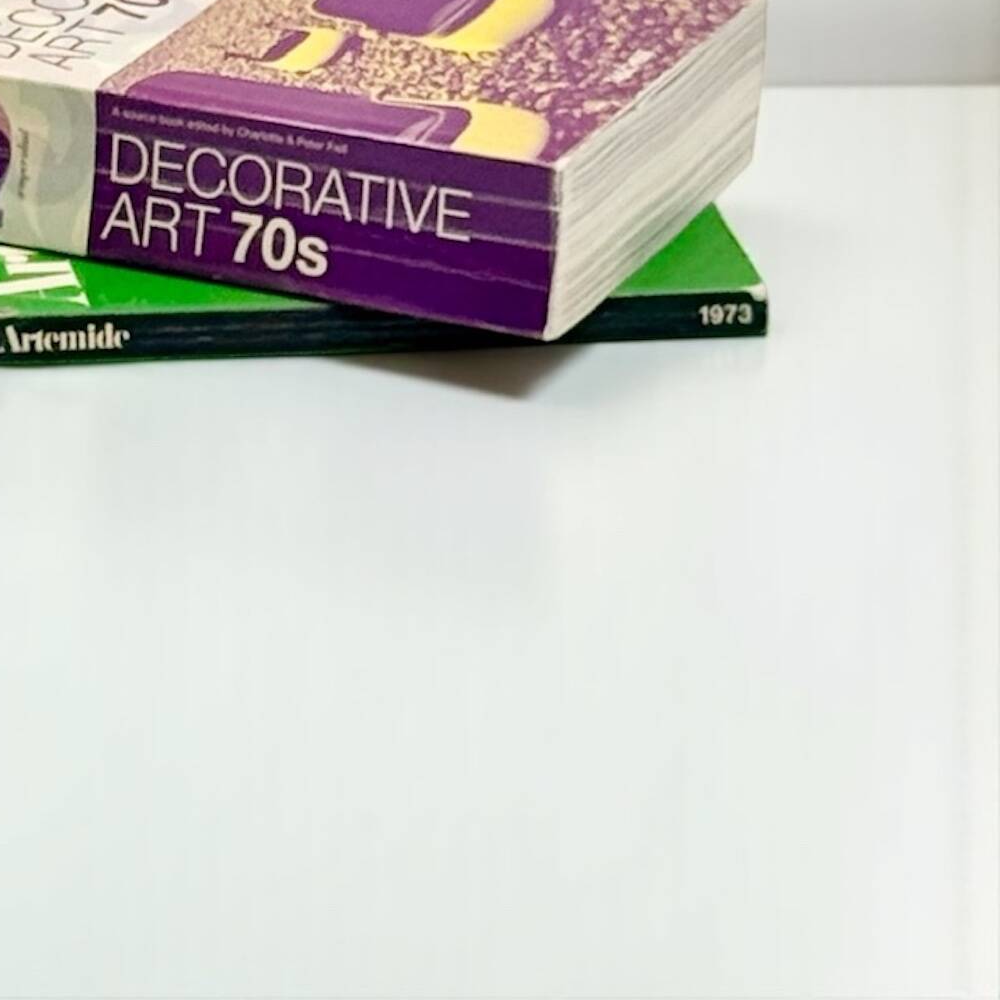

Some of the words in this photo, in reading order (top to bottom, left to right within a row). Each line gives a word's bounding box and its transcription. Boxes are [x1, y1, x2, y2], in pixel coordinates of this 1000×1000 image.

[28, 18, 125, 71] ART
[221, 123, 235, 138] by
[109, 132, 474, 243] DECORATIVE
[100, 191, 222, 257] ART
[231, 210, 329, 277] 70s
[699, 303, 753, 326] 1973
